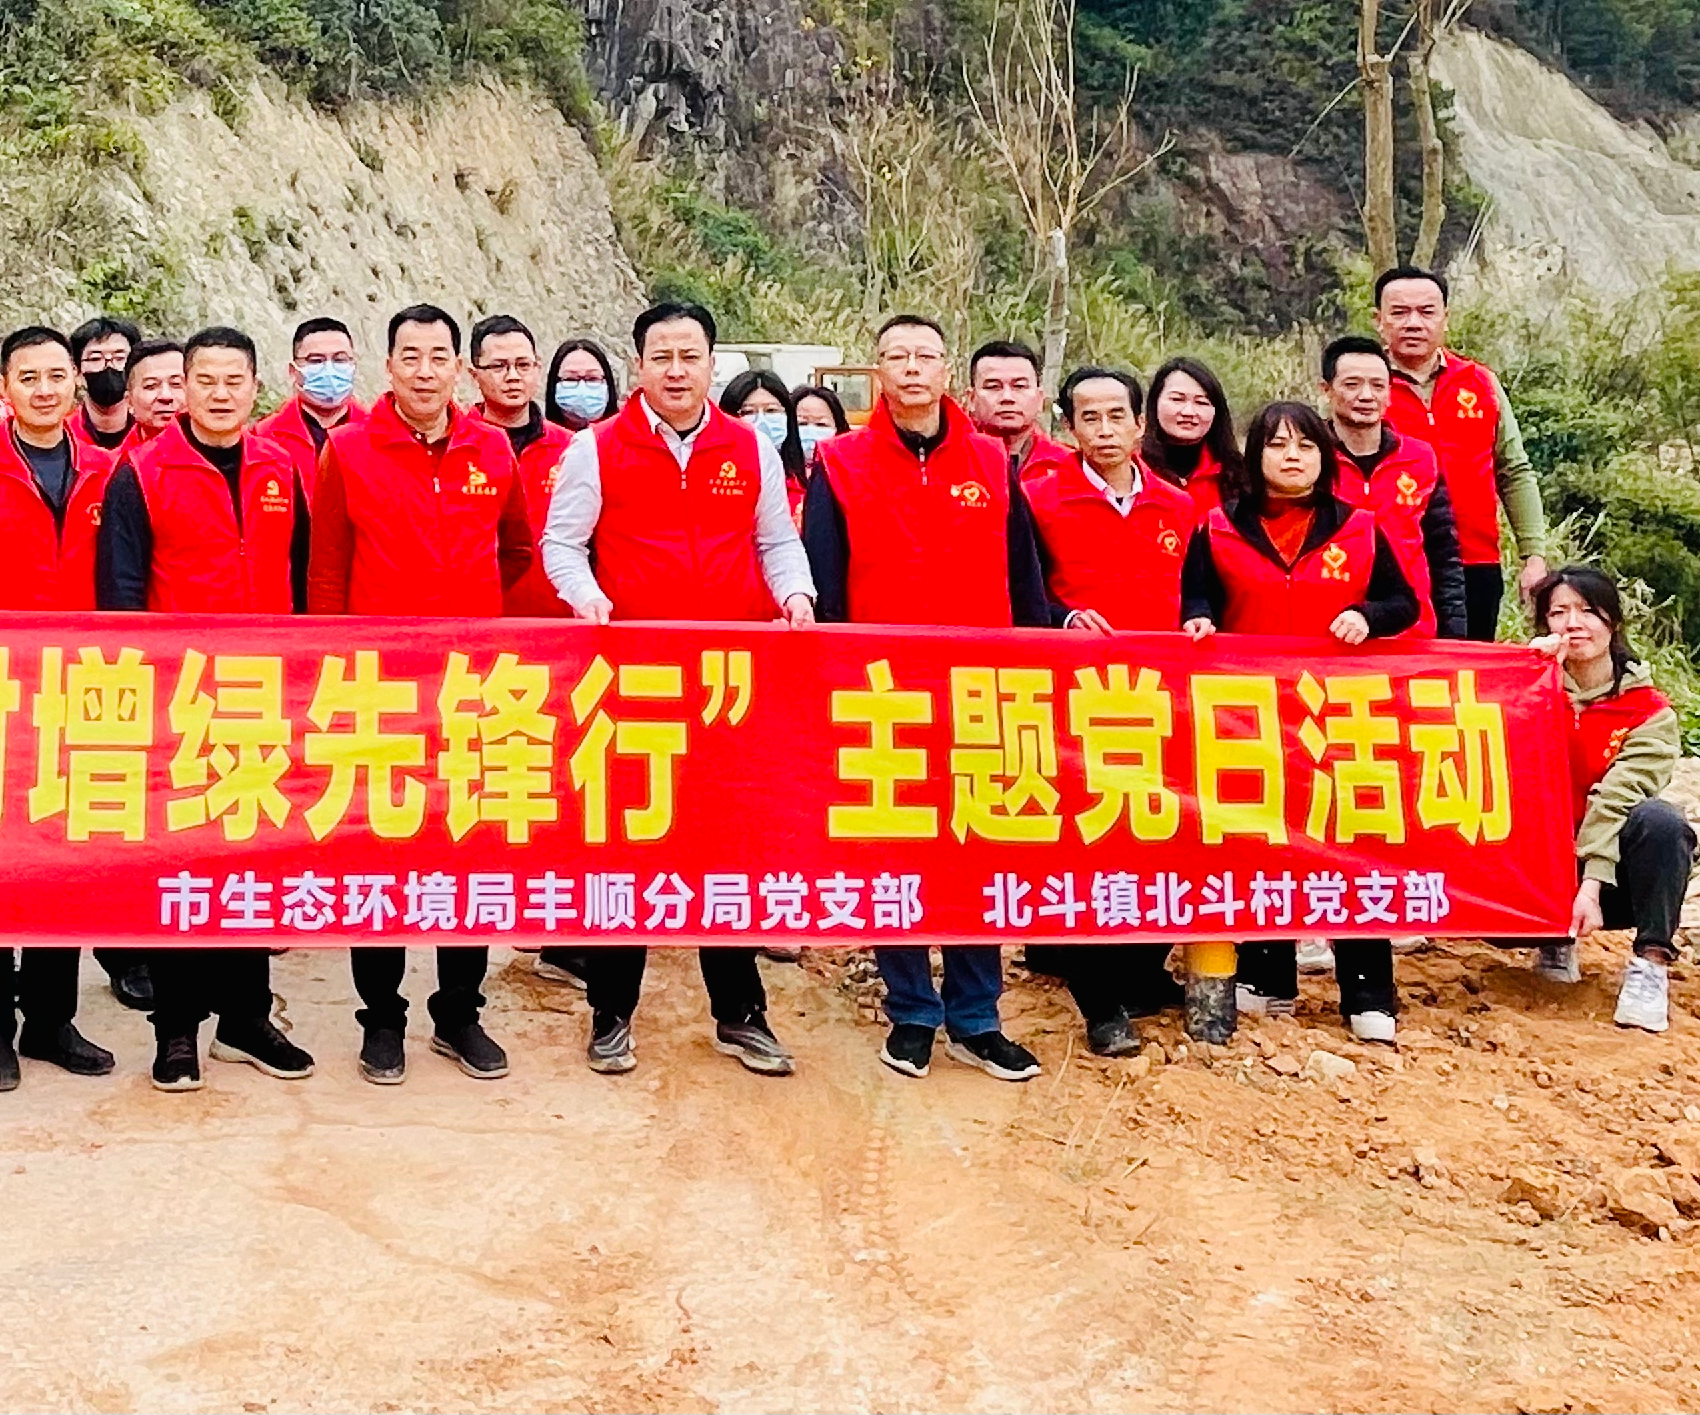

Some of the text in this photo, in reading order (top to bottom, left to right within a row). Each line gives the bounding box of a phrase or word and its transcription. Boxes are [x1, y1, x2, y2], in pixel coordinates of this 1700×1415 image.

[825, 658, 1514, 846] 主题党日活动
[156, 868, 1452, 933] 市生态环境局丰顺分局党支部 北斗镇北斗村党支部
